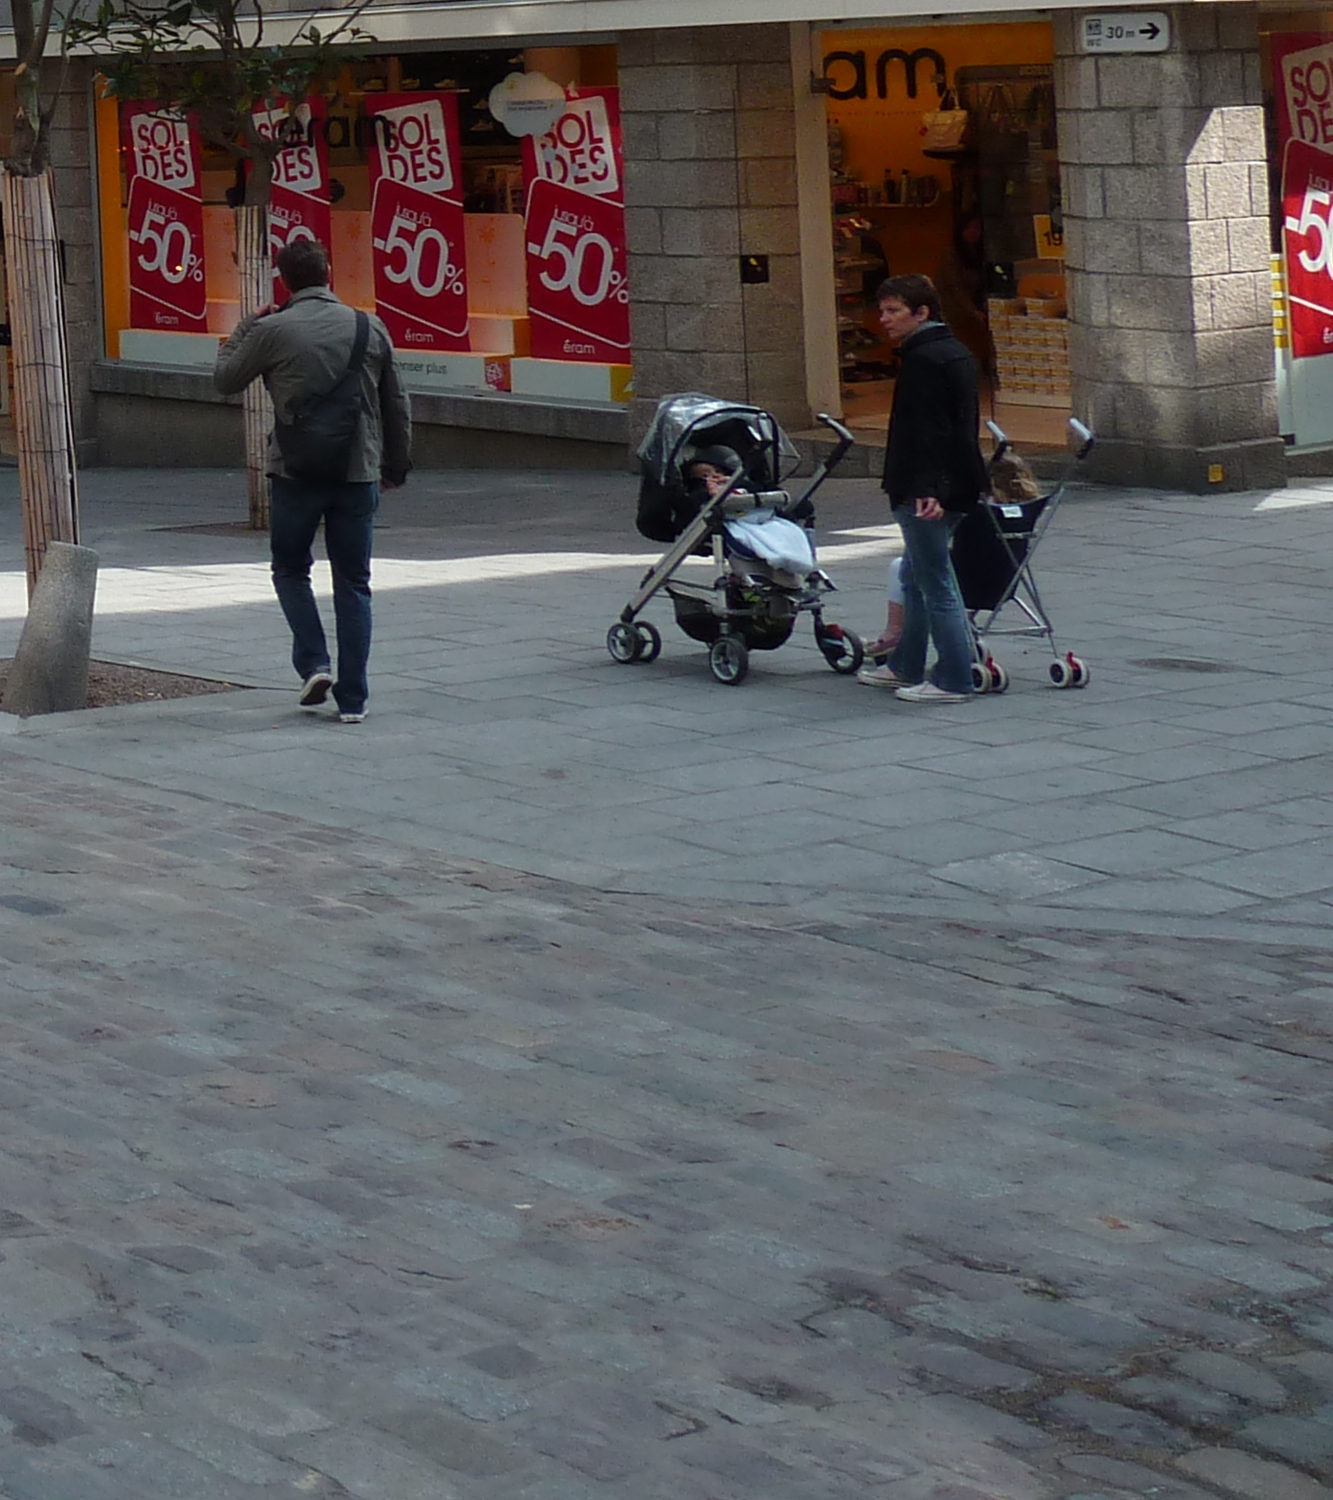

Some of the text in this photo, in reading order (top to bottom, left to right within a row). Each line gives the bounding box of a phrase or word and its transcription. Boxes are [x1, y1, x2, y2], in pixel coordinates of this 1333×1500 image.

[1106, 26, 1135, 39] 30 m
[136, 120, 187, 152] SOL
[385, 109, 441, 153] SOL
[1296, 103, 1333, 144] DE
[141, 148, 189, 182] DES
[388, 145, 445, 184] DES
[544, 148, 609, 185] DES
[405, 328, 434, 343] éram
[563, 338, 596, 355] éram
[426, 361, 447, 375] plus
